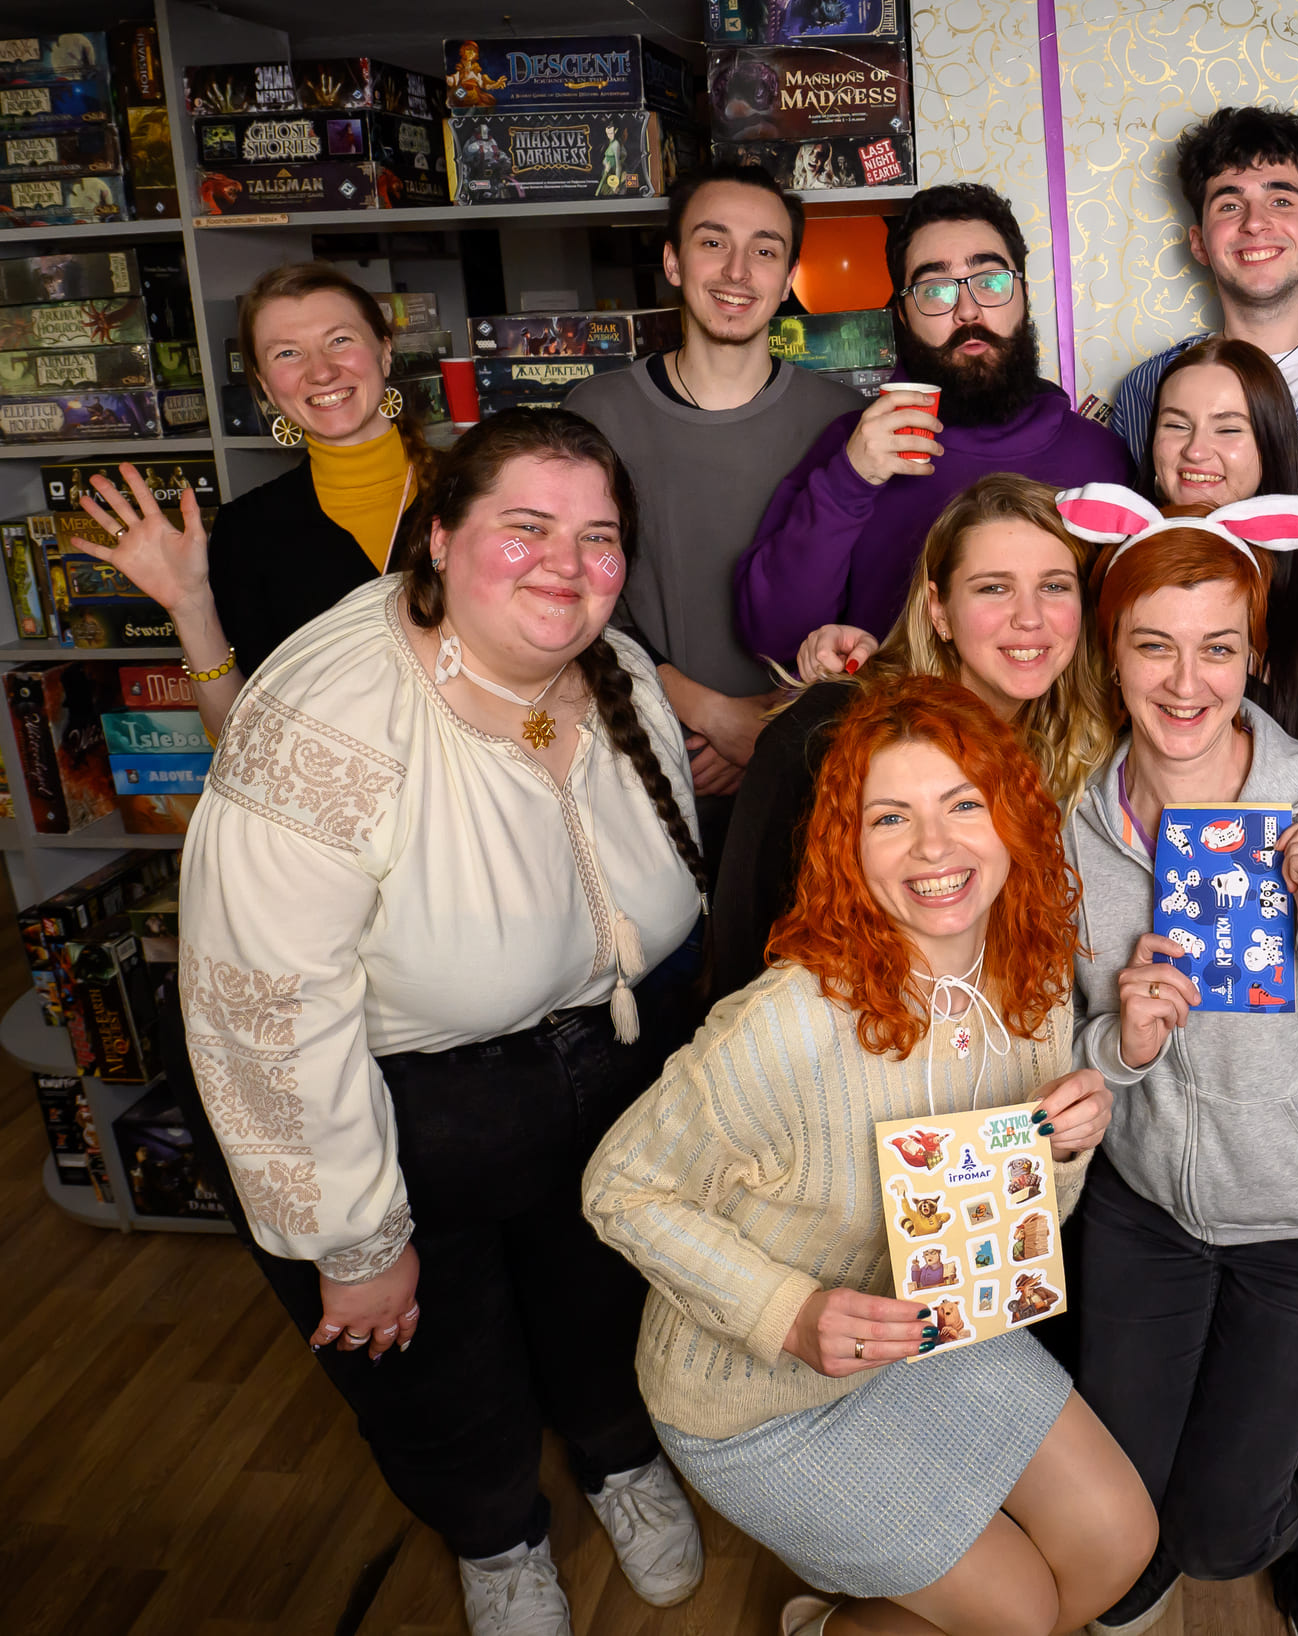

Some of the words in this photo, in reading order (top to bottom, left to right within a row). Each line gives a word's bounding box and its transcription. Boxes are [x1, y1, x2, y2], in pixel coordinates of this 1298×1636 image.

[136, 33, 150, 94] INVASION
[255, 65, 293, 91] ЗИМА
[785, 70, 864, 88] MANSIONS
[780, 87, 897, 114] MADNESS
[249, 123, 310, 140] GHOST
[513, 131, 584, 149] MASSIVE
[246, 137, 319, 155] STORIES
[860, 140, 890, 160] LAST
[516, 147, 588, 166] DARKNESS
[864, 152, 895, 171] NIGHT
[872, 163, 900, 182] EARTH
[246, 177, 325, 193] TALISMAN
[516, 366, 541, 377] ЖАХ
[149, 770, 194, 783] ABOVE
[990, 1131, 1032, 1150] ДРУК
